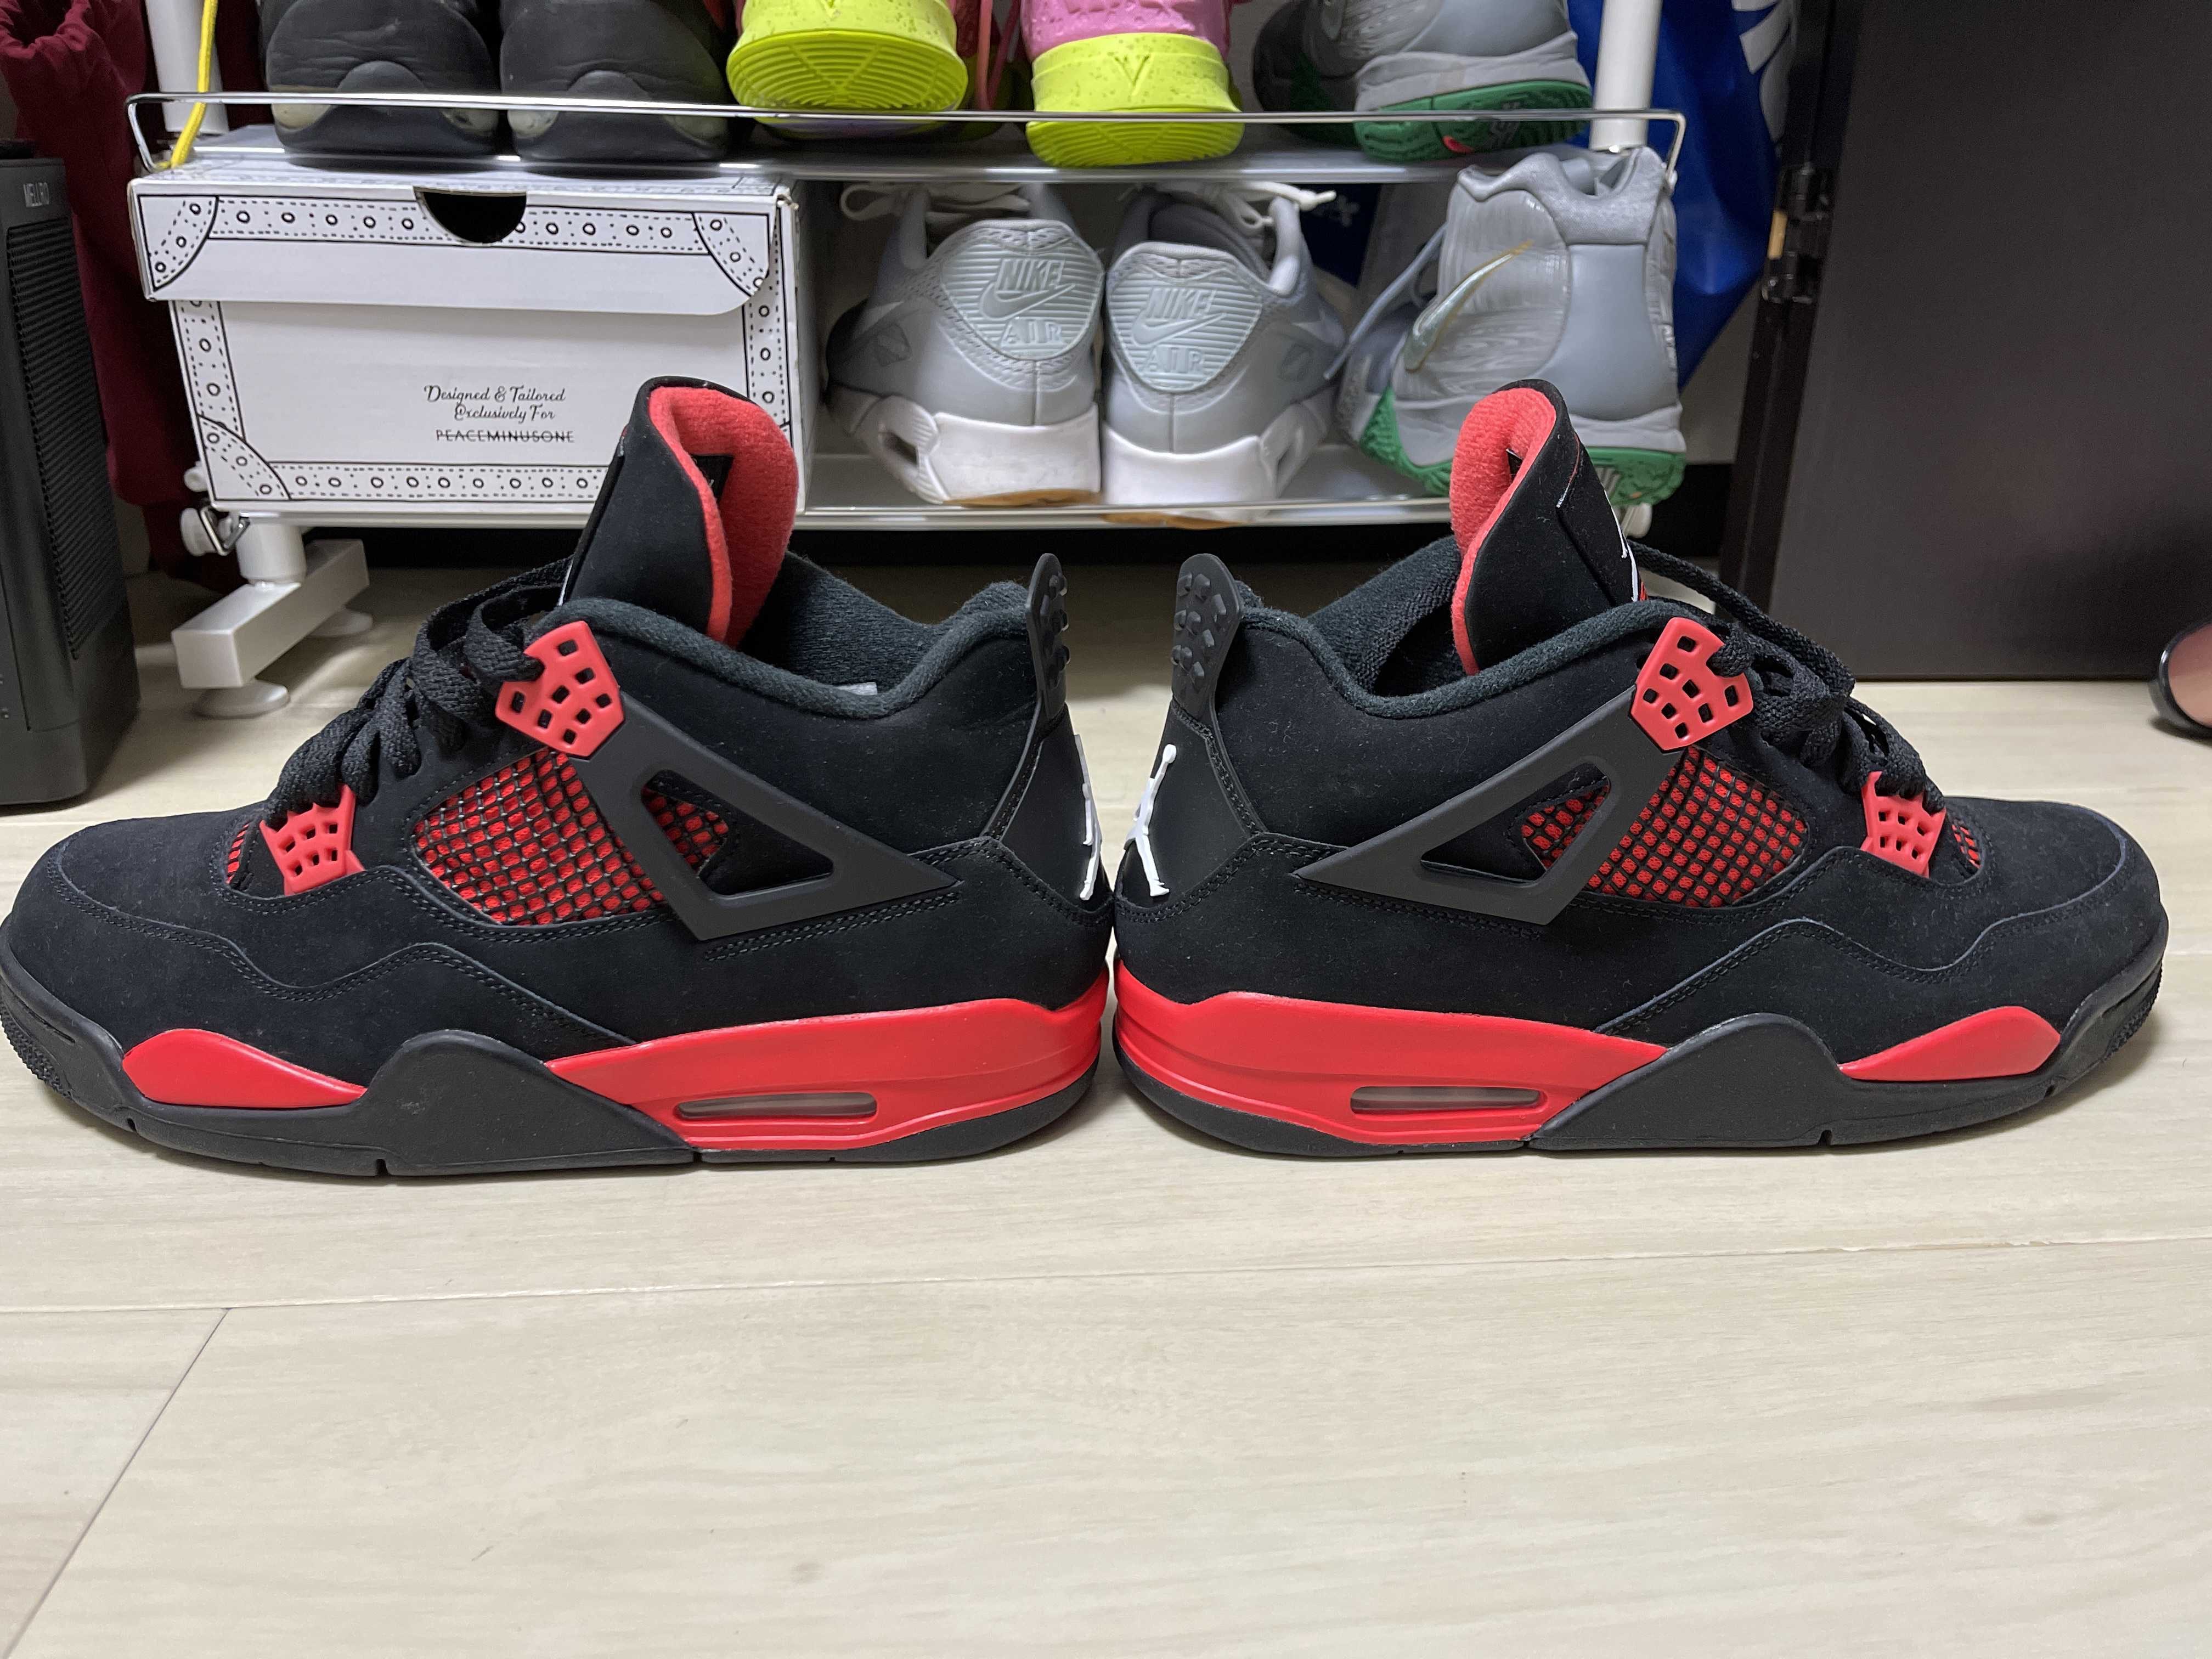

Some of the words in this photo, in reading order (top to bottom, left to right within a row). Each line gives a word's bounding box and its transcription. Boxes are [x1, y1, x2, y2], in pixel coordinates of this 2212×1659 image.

[995, 259, 1065, 291] NIKE
[1147, 287, 1216, 320] NIKE
[1001, 319, 1064, 346] AIR
[1146, 344, 1207, 374] AIR
[424, 385, 490, 403] Designed
[494, 386, 506, 402] &
[510, 385, 566, 402] Tailored
[454, 403, 528, 424] Exclusively
[529, 403, 556, 421] For
[436, 430, 574, 442] PEACEMINUSONE
